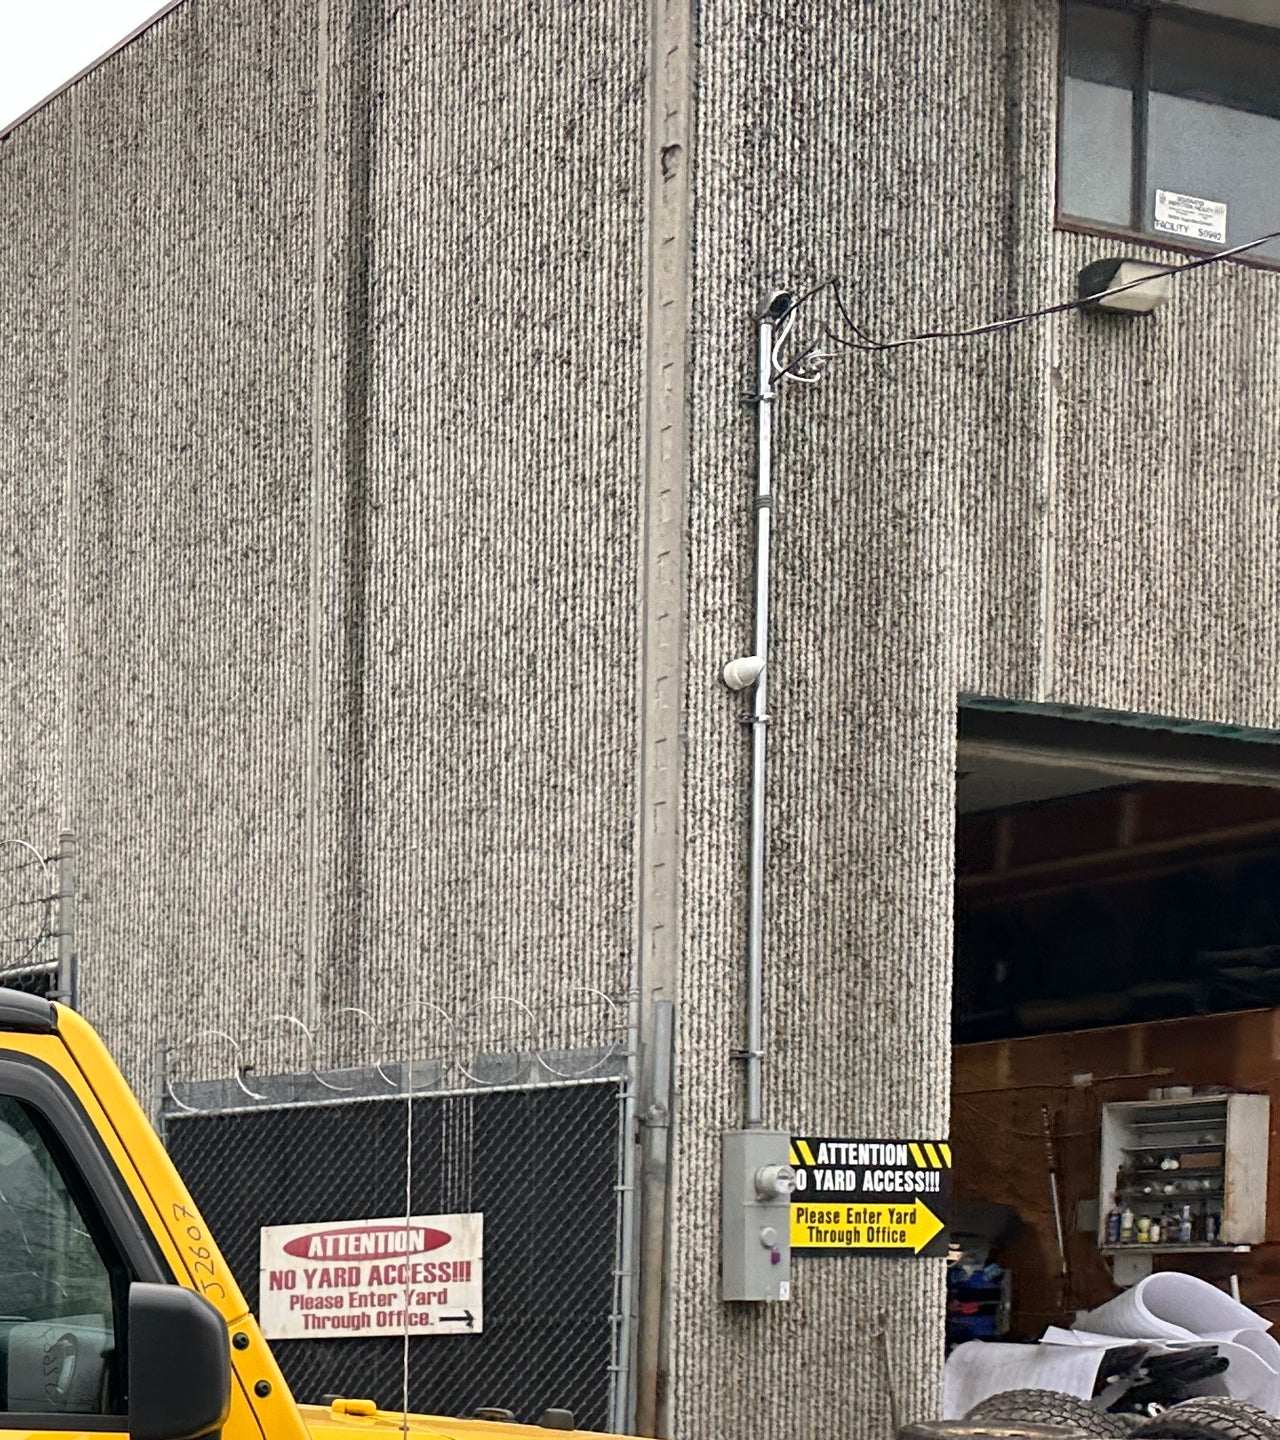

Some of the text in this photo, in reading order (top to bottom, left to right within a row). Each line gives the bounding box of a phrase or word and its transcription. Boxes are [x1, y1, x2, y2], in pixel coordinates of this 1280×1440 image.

[817, 1142, 908, 1166] ATTENTION
[814, 1170, 857, 1192] YARD
[862, 1170, 941, 1193] ACCESS!!!
[796, 1207, 917, 1224] Please Enter Yard
[307, 1228, 426, 1258] ATTENTION
[806, 1226, 907, 1245] Through Office
[172, 1203, 226, 1300] J2607
[269, 1261, 472, 1291] NO YARD ACCESS!!!
[290, 1288, 448, 1311] Please Enter Yard
[302, 1312, 371, 1332] Through
